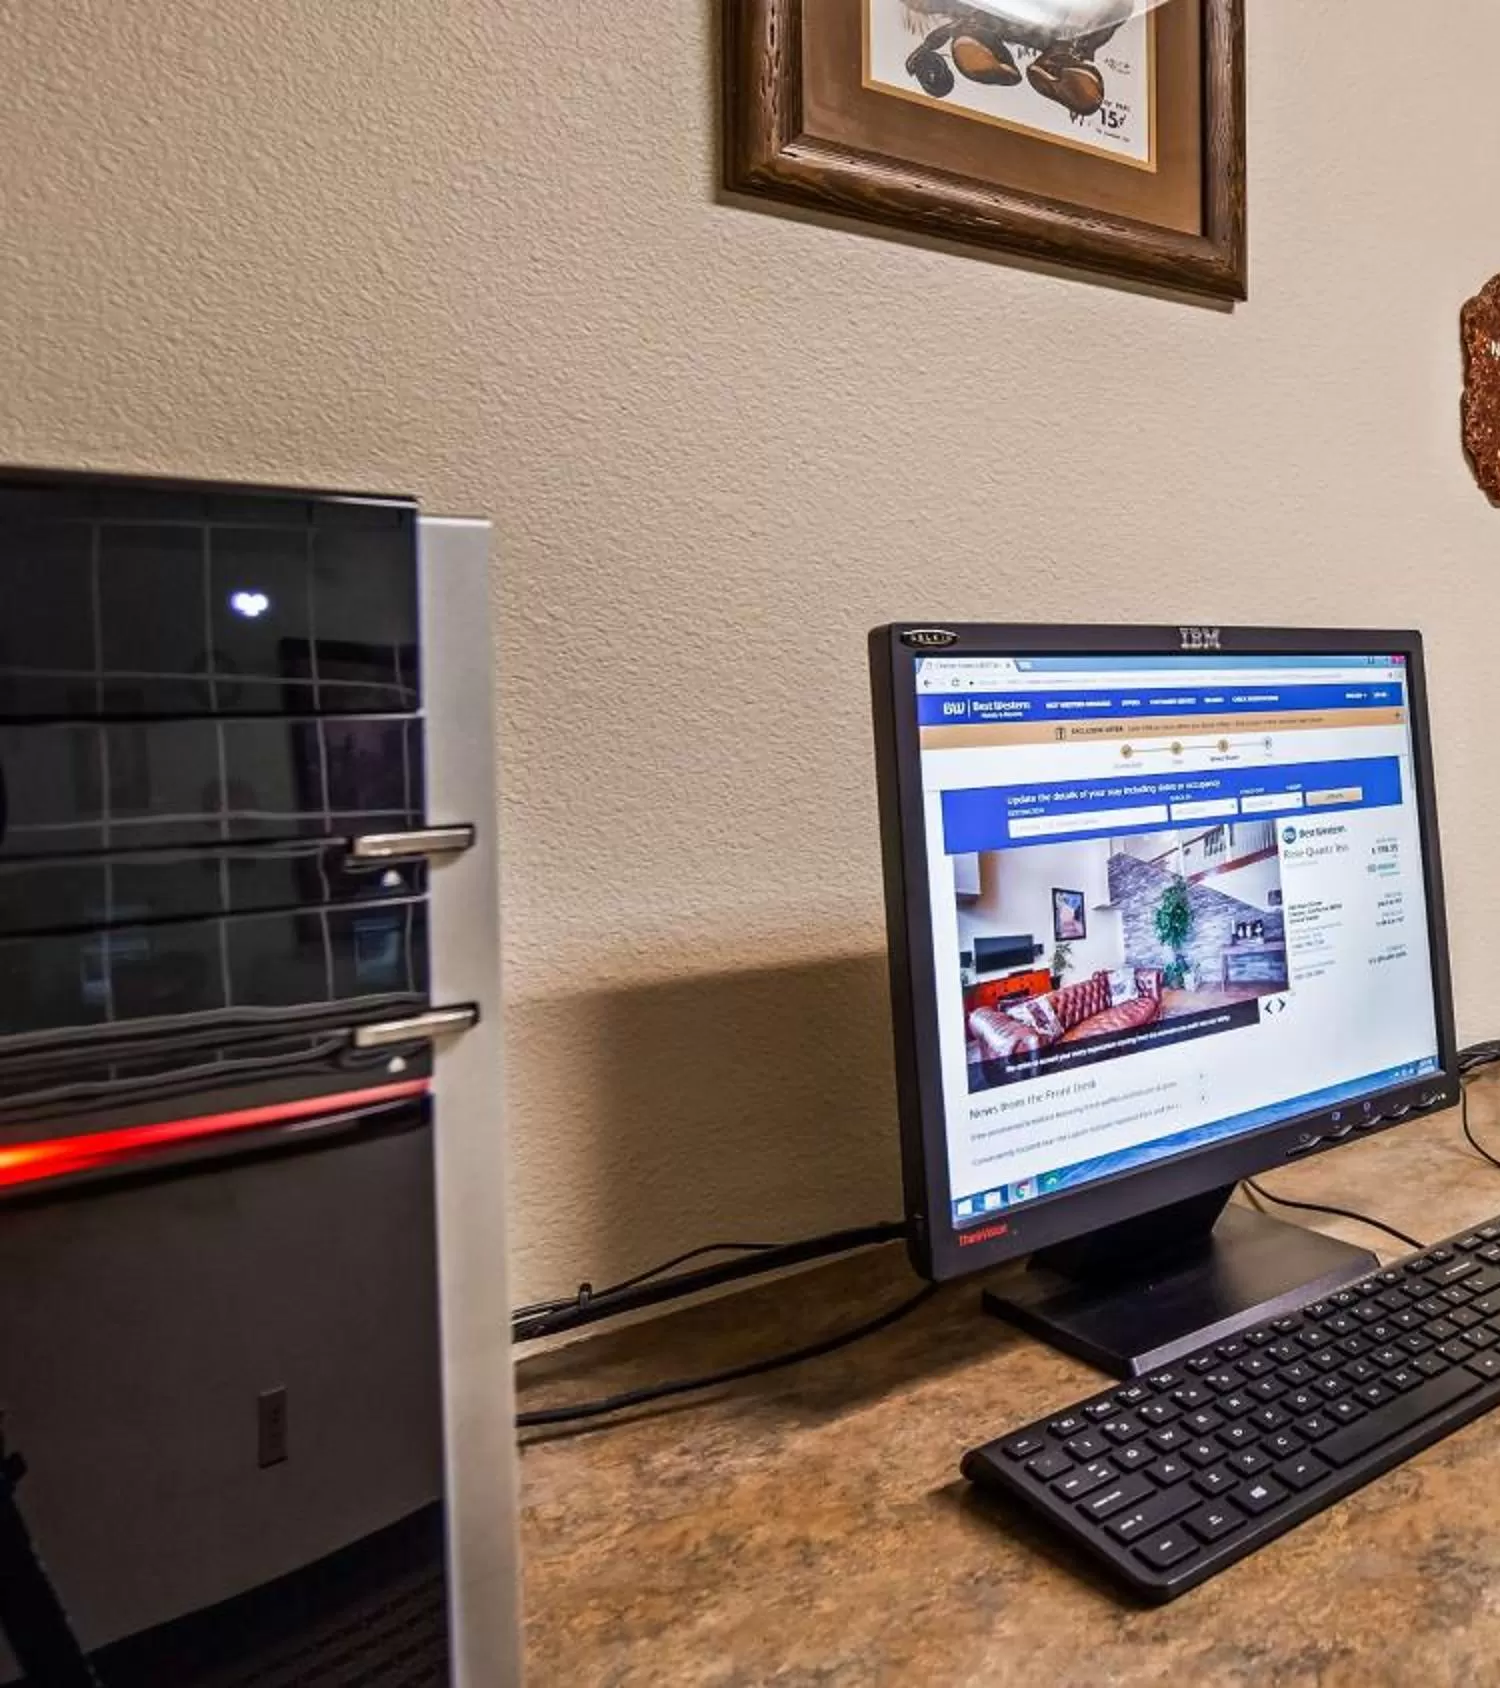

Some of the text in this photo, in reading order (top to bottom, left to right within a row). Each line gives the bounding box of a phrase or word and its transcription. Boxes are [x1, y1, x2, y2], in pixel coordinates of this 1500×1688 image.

[1179, 627, 1221, 649] IBM
[993, 700, 1032, 711] Western
[969, 1106, 998, 1120] News
